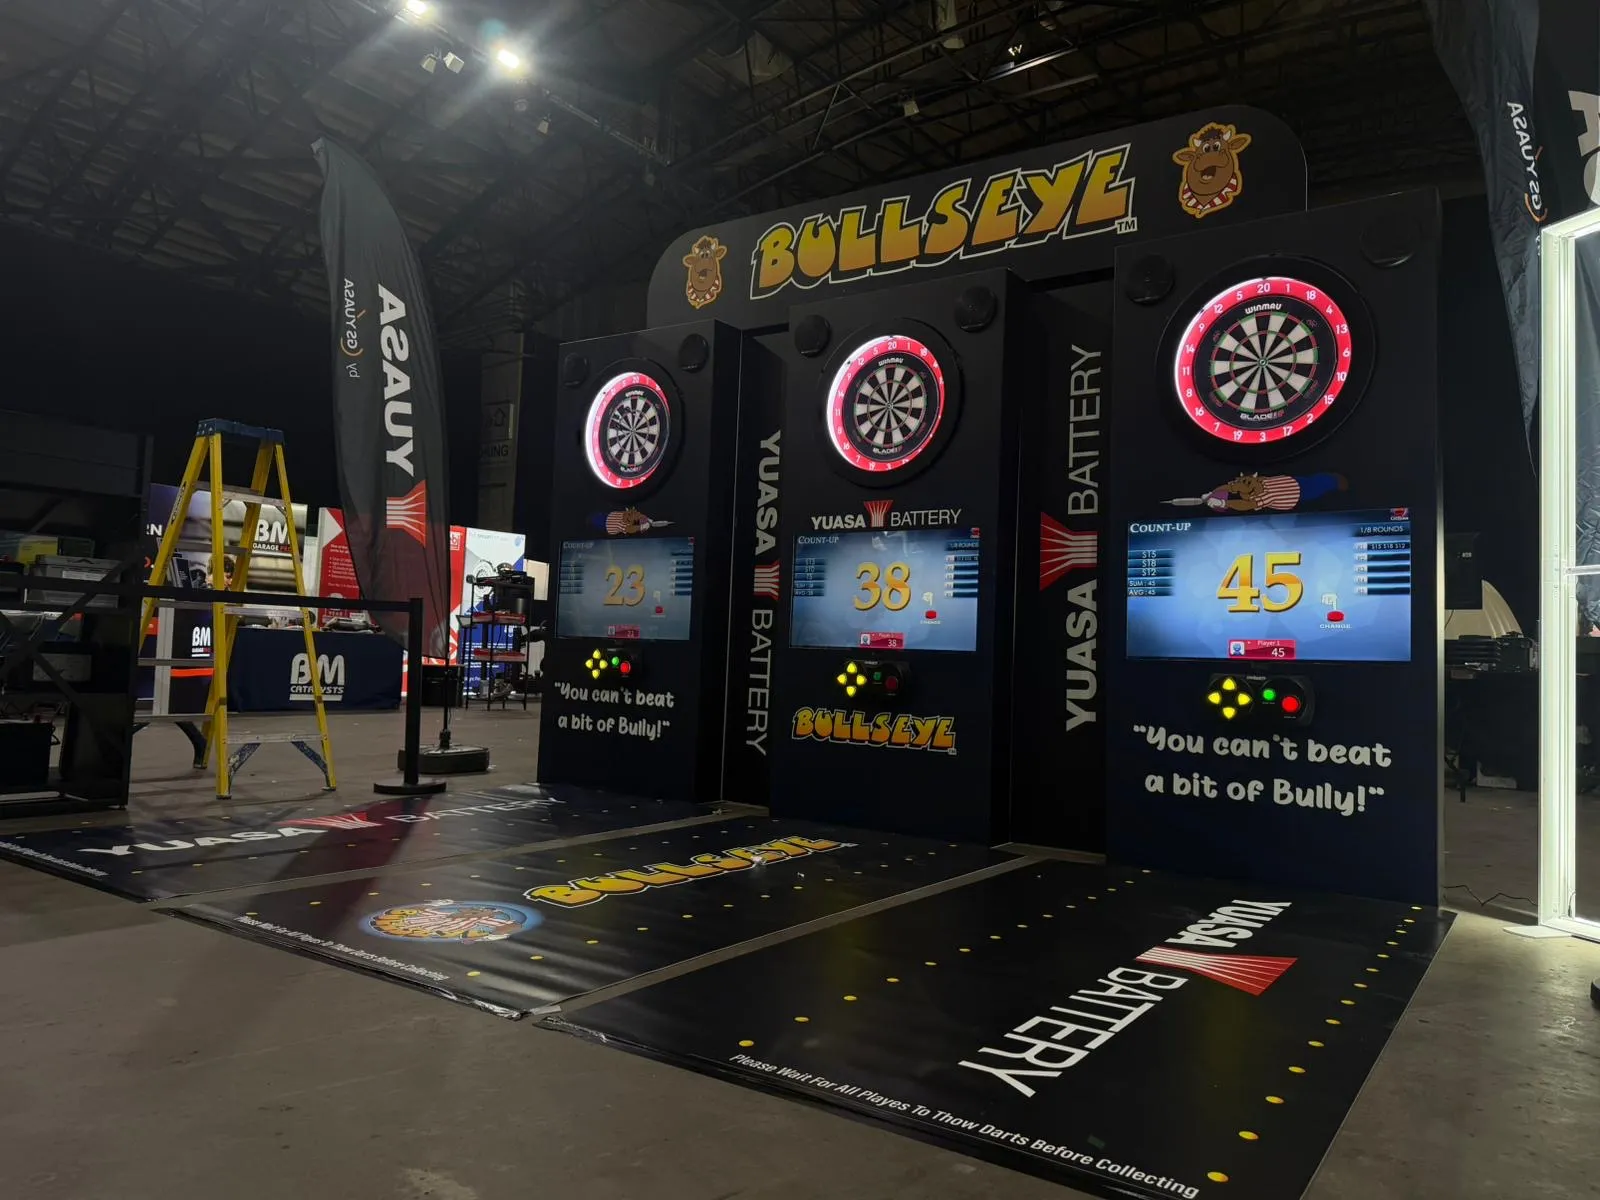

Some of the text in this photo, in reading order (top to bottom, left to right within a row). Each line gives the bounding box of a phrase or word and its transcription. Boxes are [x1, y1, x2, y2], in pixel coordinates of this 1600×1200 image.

[750, 144, 1135, 299] BULLSEYE
[1257, 283, 1270, 293] 20
[1306, 290, 1316, 300] 18
[1214, 304, 1223, 314] 12
[1336, 324, 1348, 334] 13
[1186, 345, 1195, 353] 14
[1182, 367, 1190, 376] 11
[1337, 372, 1347, 381] 10
[1324, 395, 1334, 405] 15
[1195, 407, 1204, 416] 16
[1068, 344, 1101, 515] BATTERY
[1233, 430, 1243, 440] 19
[1283, 426, 1293, 436] 17
[755, 429, 781, 555] YUASA
[811, 508, 962, 530] YUASA BATTERY
[1130, 522, 1191, 534] COUNT-UP
[1373, 525, 1404, 533] ROUNDS
[798, 535, 840, 544] COUNT-UP
[1142, 550, 1156, 558] S15
[1142, 559, 1156, 567] S18
[1142, 568, 1156, 576] S12
[603, 564, 646, 607] 23
[853, 561, 912, 611] 38
[1216, 552, 1303, 613] 45
[192, 626, 211, 646] BM
[887, 639, 897, 647] 38
[1066, 578, 1097, 732] YUASA
[1271, 647, 1285, 657] 45
[290, 652, 345, 686] BM
[290, 685, 344, 694] CATAYSTS
[746, 608, 774, 756] BATTERY
[636, 689, 675, 708] beat
[558, 715, 567, 728] a
[571, 713, 593, 731] bit
[597, 717, 615, 733] of
[792, 707, 957, 752] BULLSEYE
[1213, 734, 1298, 761] can't
[1307, 739, 1392, 767] beat
[1145, 773, 1164, 793] a
[1173, 772, 1218, 798] bit
[1226, 780, 1264, 801] of
[77, 827, 330, 856] YUASA
[523, 836, 848, 908] BULLSEYE
[957, 900, 1292, 1098] YUASA BATTERY
[729, 1053, 1200, 1199] Please Wait For All Playes To Thow Darts Before Collecting
